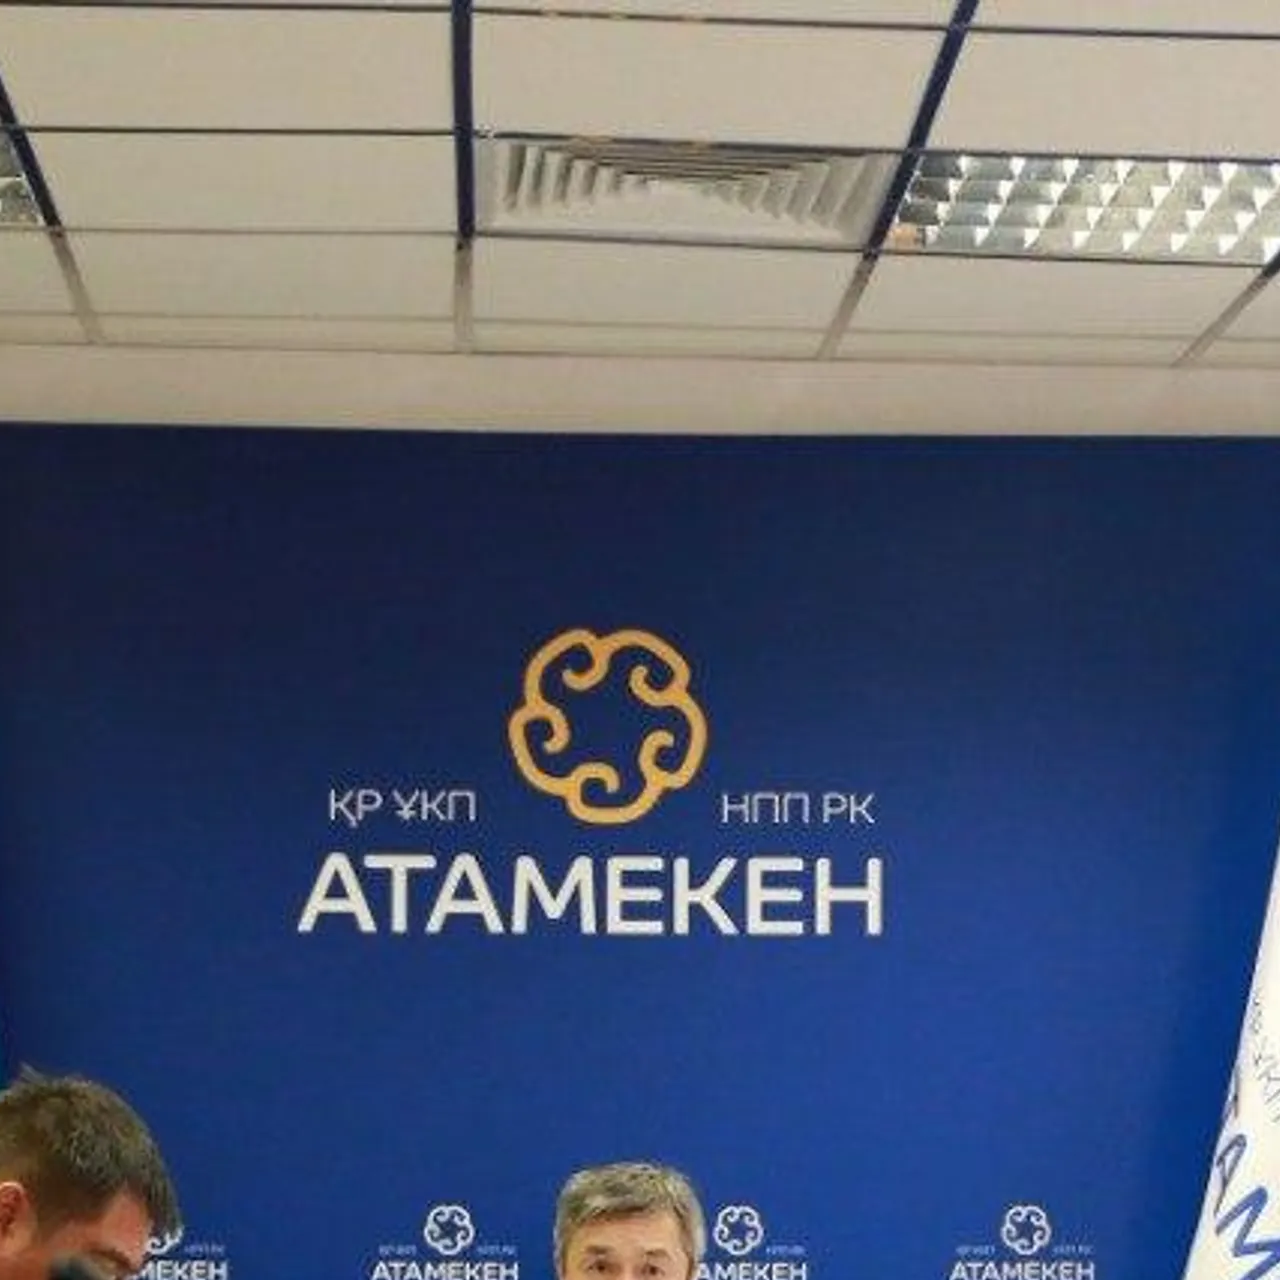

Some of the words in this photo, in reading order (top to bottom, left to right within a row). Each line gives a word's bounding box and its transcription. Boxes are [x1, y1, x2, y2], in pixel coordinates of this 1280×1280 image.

[328, 790, 382, 828] ҚР
[392, 791, 477, 822] ҰКП
[722, 793, 811, 824] НПП
[823, 795, 875, 824] РК
[297, 851, 884, 936] АТАМЕКЕН
